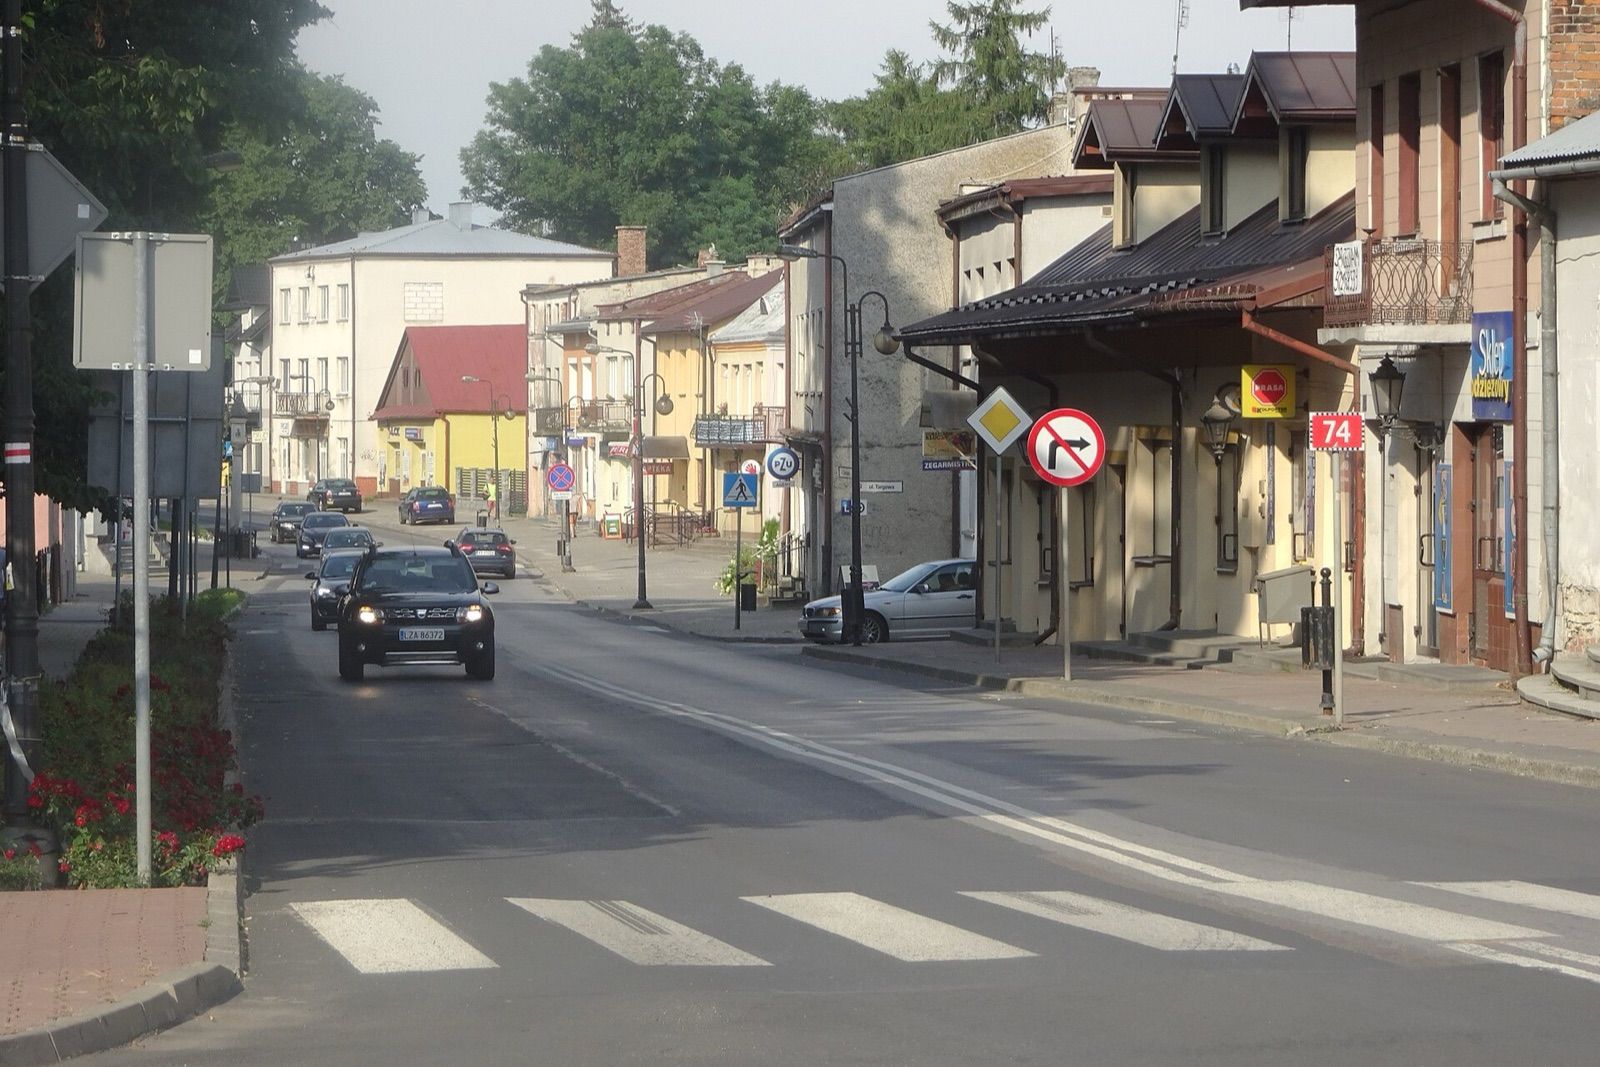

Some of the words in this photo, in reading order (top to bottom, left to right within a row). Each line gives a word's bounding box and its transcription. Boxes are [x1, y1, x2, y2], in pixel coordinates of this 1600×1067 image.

[1479, 328, 1504, 379] Sklep
[1255, 384, 1284, 392] PRASA
[1322, 419, 1351, 443] 74
[774, 457, 792, 471] PZU
[404, 631, 419, 640] LZA
[420, 631, 443, 640] 86372
